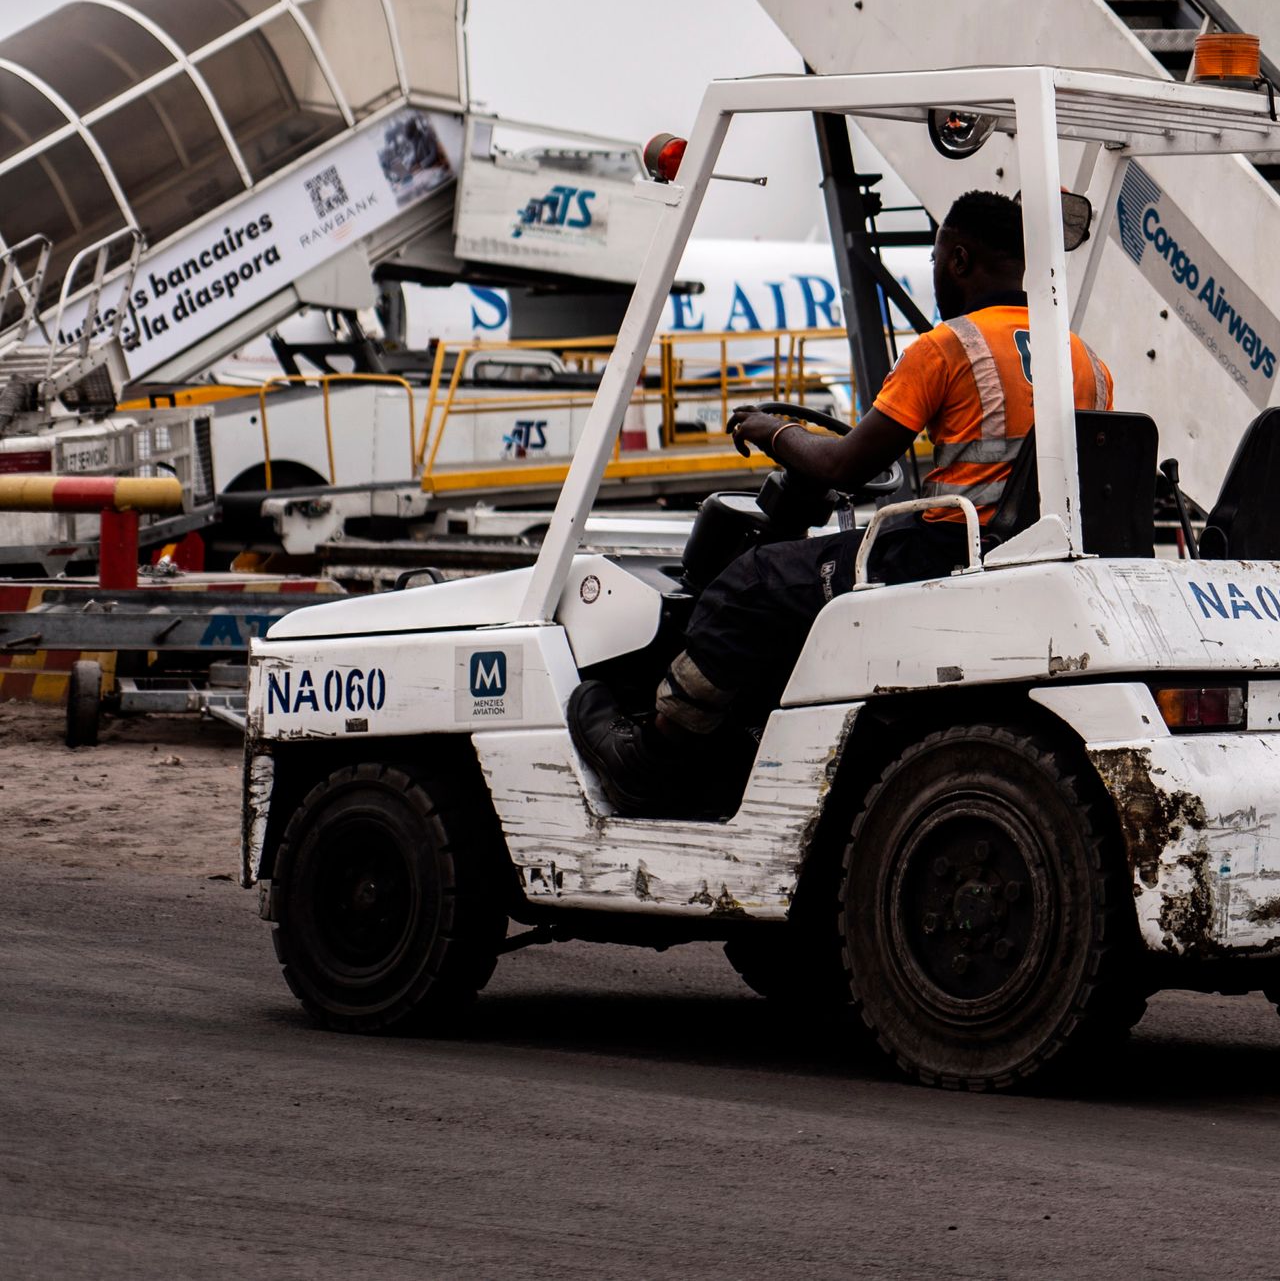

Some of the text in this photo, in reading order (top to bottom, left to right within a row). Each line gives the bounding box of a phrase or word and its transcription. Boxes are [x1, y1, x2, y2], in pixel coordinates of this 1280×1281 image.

[298, 192, 380, 248] RAWBANK
[148, 212, 274, 299] bancaires
[141, 315, 170, 341] la
[171, 244, 281, 323] diaspora
[1142, 207, 1278, 379] Congo Airways
[268, 668, 386, 715] NA060
[472, 707, 506, 716] AVIATION
[473, 699, 504, 709] MENZIES
